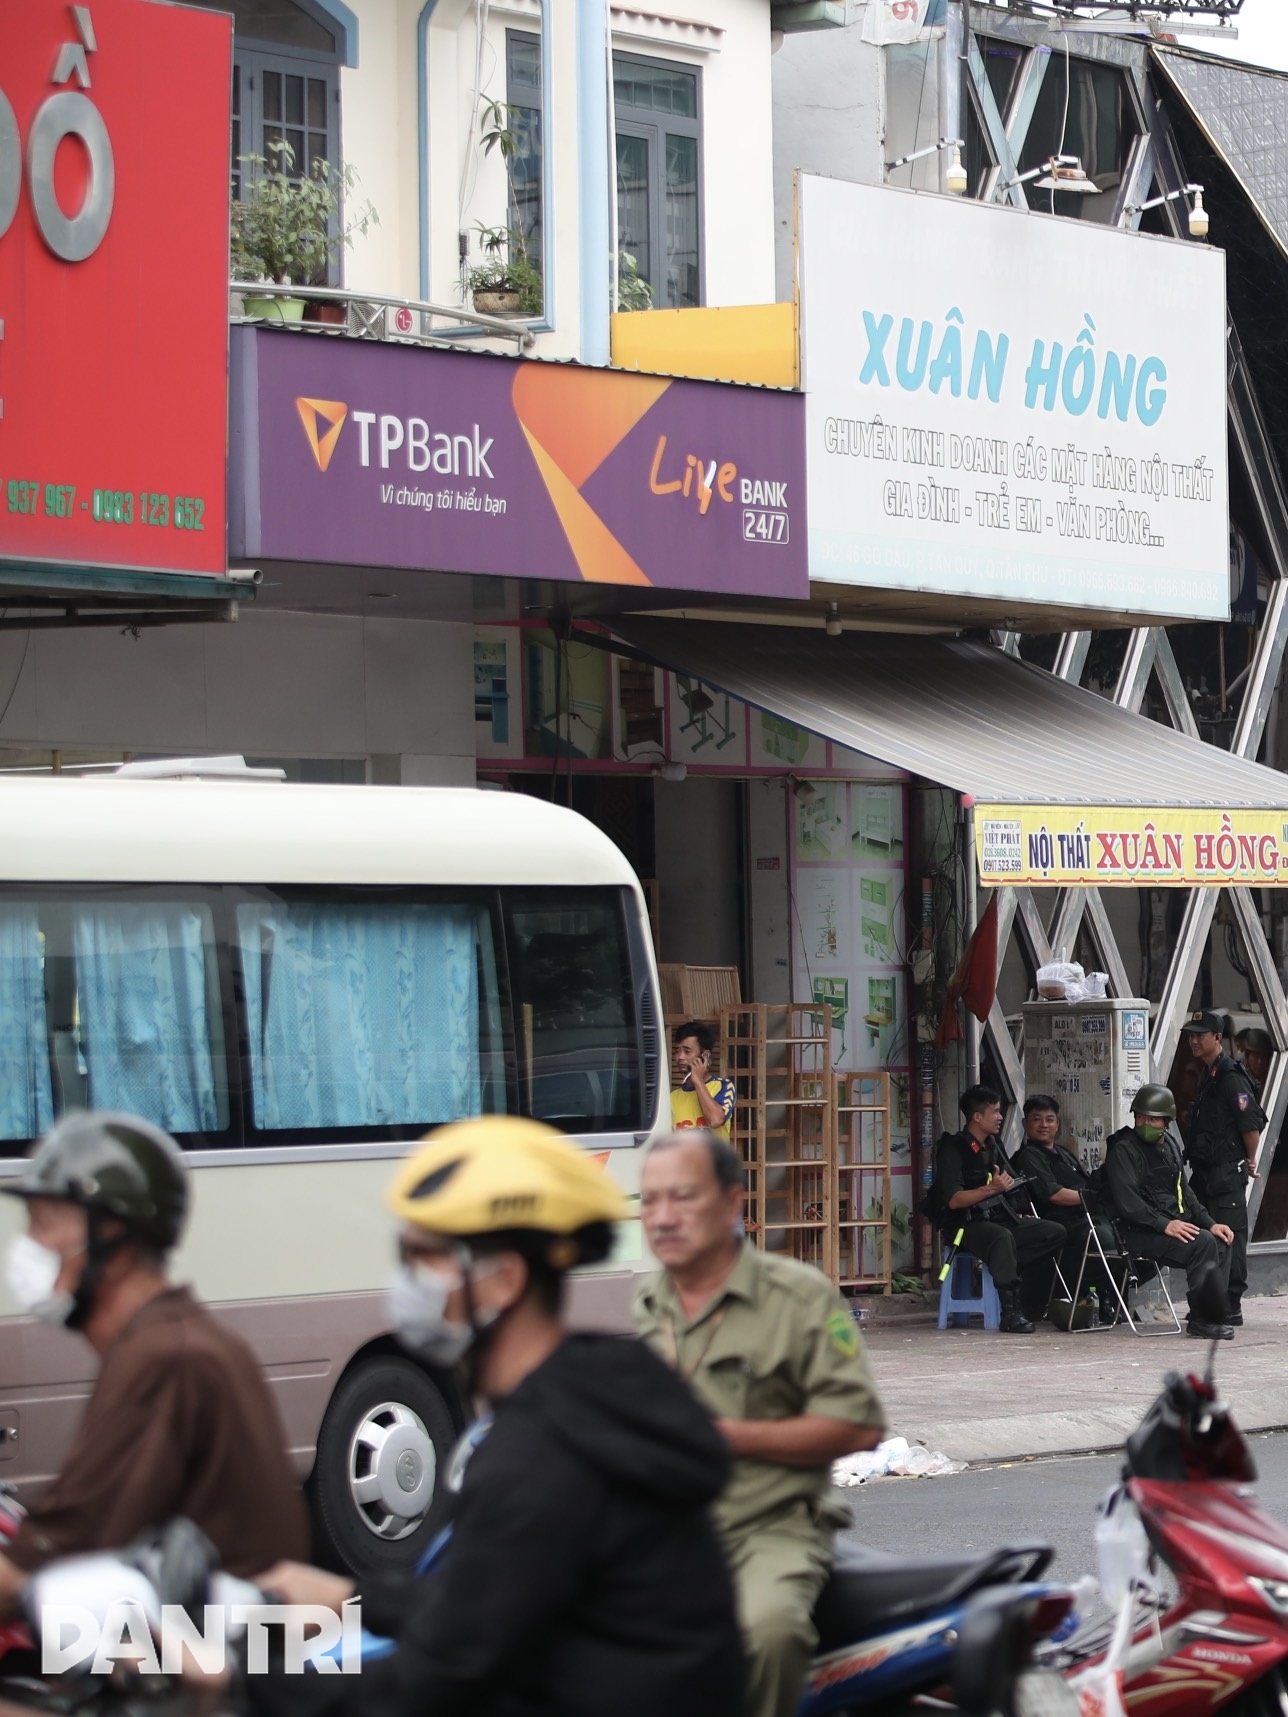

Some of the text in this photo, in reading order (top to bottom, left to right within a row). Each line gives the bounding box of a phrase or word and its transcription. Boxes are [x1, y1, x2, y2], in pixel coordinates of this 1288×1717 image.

[0, 5, 115, 262] Ồ
[859, 306, 1168, 427] XUÂN HỒNG
[353, 410, 495, 479] TPBank
[650, 435, 737, 515] Live
[823, 414, 1214, 505] CHUYÊN KINH DOANH CÁC MẶT HÀNG NỘI THẤT
[7, 480, 40, 515] 937
[44, 483, 77, 518] 967
[92, 488, 135, 525] 0983
[140, 492, 170, 527] 123
[174, 495, 206, 531] 652
[381, 483, 507, 517] Vì chúng tôi hiểu bạn
[740, 478, 788, 508] BANK
[883, 479, 914, 518] GIA
[917, 476, 961, 523] ĐÌNH
[975, 482, 1010, 530] TRẺ
[1015, 496, 1042, 534] EM
[1057, 497, 1091, 539] VĂN
[744, 511, 786, 542] 24/7
[1000, 829, 1021, 845] PHÁT
[1028, 813, 1280, 883] NỘI THẤT XUÂN HỒNG
[1191, 1646, 1253, 1666] HONDA
